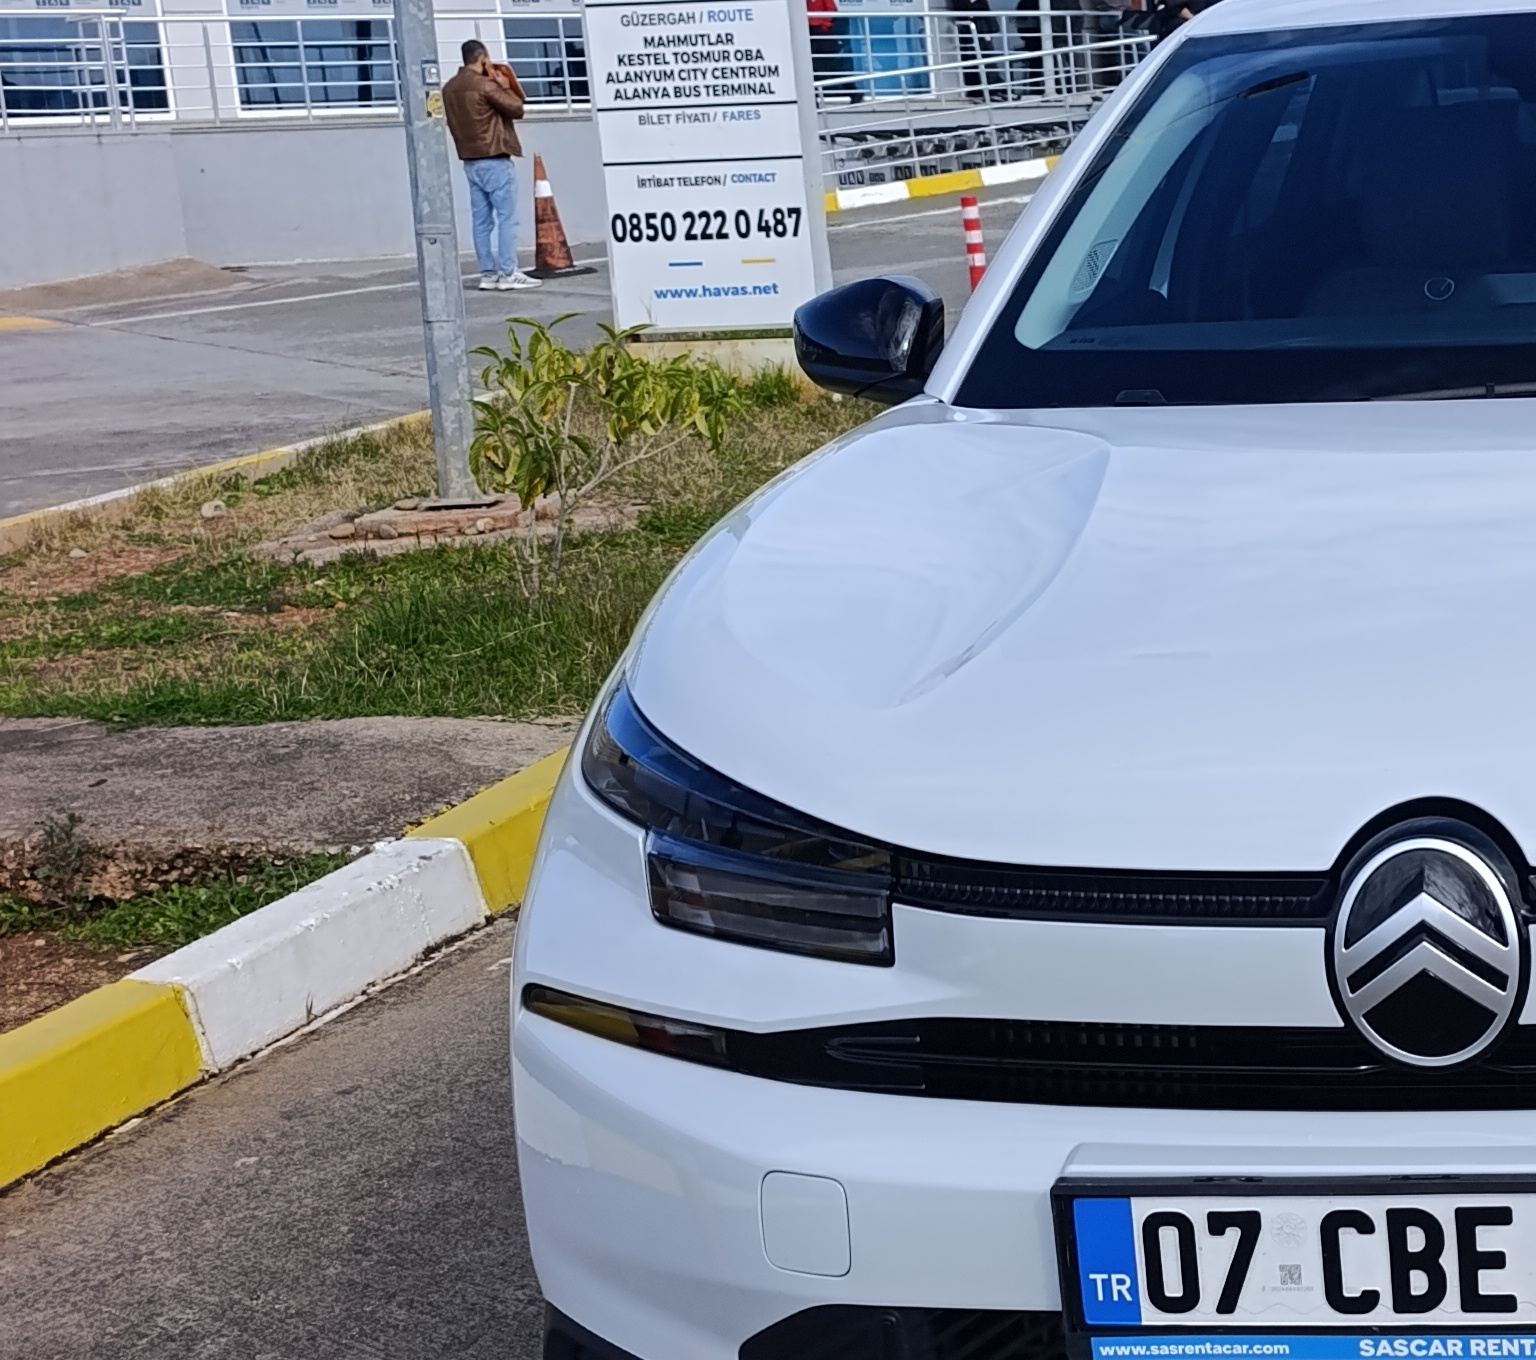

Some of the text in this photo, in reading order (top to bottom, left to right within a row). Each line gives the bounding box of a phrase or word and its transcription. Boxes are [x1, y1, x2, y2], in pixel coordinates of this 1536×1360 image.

[620, 10, 697, 27] GÜZERGAH
[707, 8, 754, 23] ROUTE
[643, 32, 735, 49] MAHMUTLAR
[617, 48, 765, 67] KESTEL TOSMUR OBA
[606, 65, 780, 84] ALANYUM CITY CENTRUM
[614, 82, 776, 101] ALANYA BUS TERMINAL
[638, 111, 673, 126] BİLET
[676, 110, 711, 125] FİYATI
[722, 109, 762, 122] FARES
[636, 174, 675, 189] İRTİBAT
[677, 176, 722, 188] TELEFON
[731, 172, 777, 184] CONTACT
[611, 207, 802, 243] 0850 222 0 487
[654, 282, 780, 300] www.havas.net
[1089, 1273, 1133, 1302] TR
[1142, 1209, 1262, 1315] 07
[1320, 1205, 1518, 1315] CBE
[1099, 1342, 1290, 1358] www.sasrentacar.com
[1359, 1339, 1464, 1358] SASCAR
